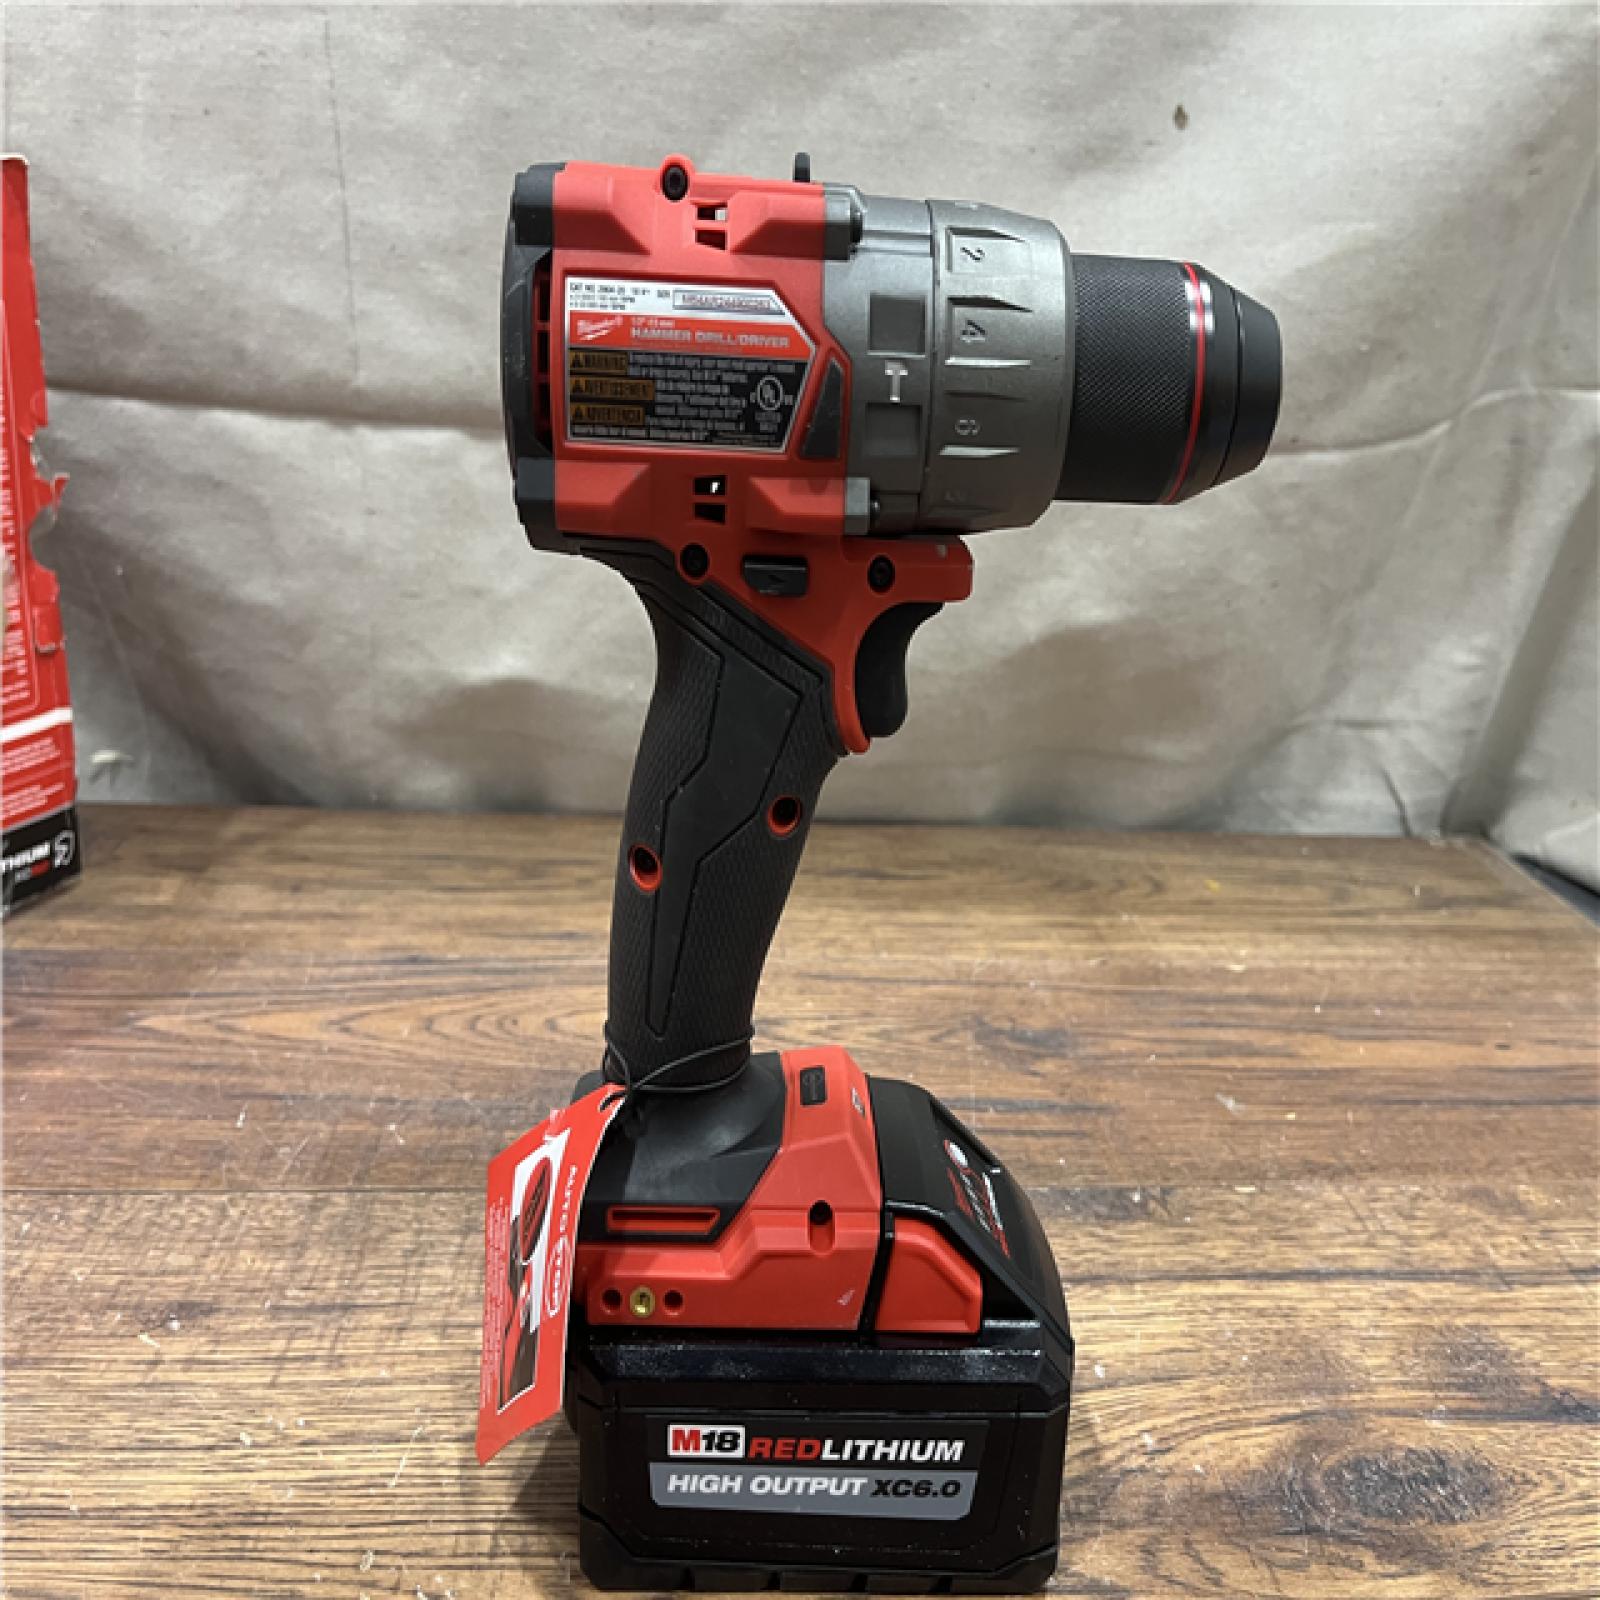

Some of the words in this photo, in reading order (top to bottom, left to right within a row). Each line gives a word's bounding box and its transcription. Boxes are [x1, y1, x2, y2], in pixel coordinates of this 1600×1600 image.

[960, 246, 985, 262] 2
[961, 319, 986, 342] 4
[671, 1428, 743, 1454] M18
[750, 1437, 966, 1462] REDLITHIUM
[667, 1474, 743, 1494] HIGH
[749, 1476, 868, 1497] OUTPUT
[870, 1479, 961, 1498] XC6.0
